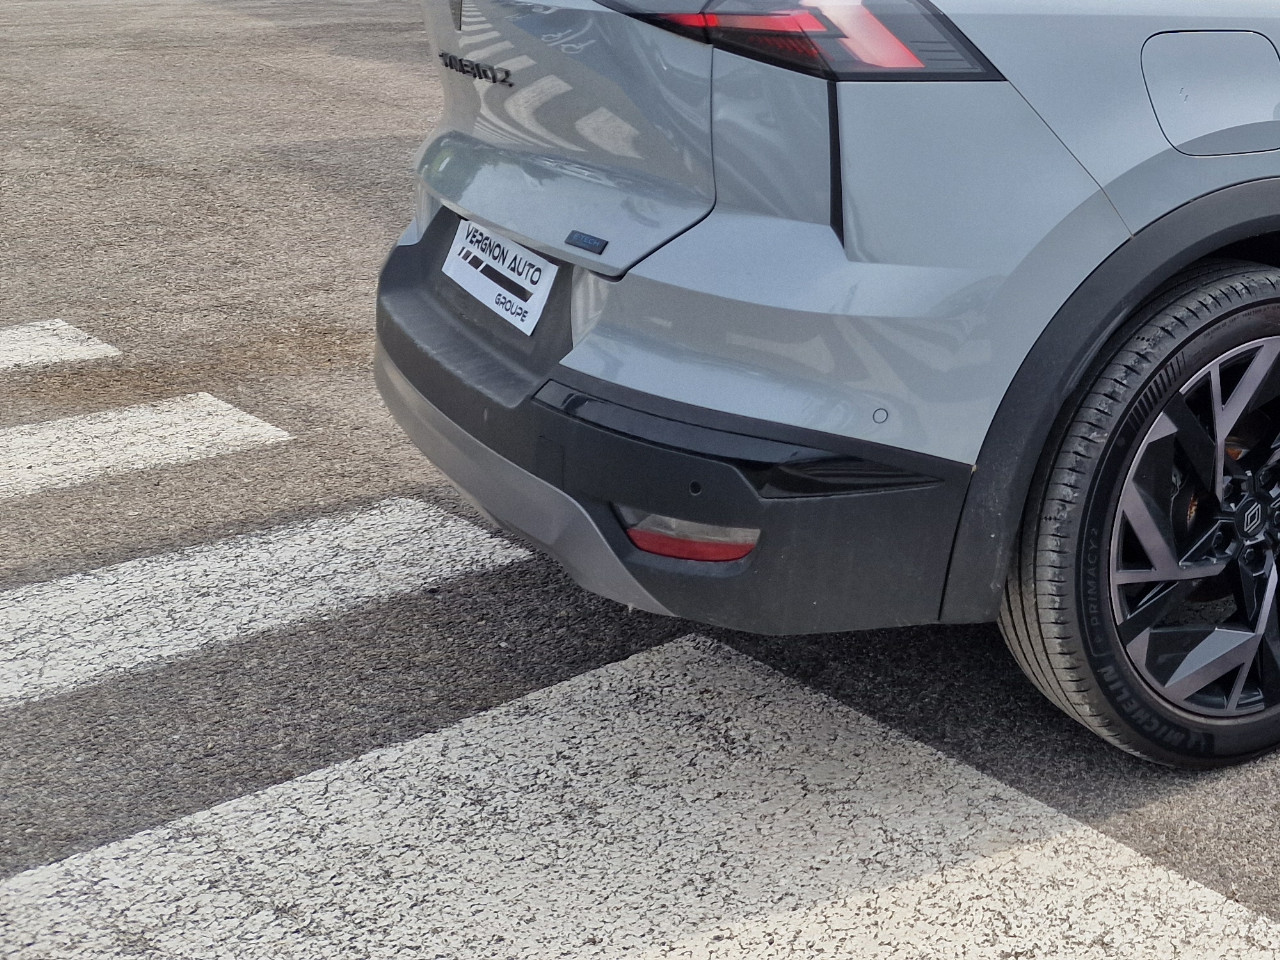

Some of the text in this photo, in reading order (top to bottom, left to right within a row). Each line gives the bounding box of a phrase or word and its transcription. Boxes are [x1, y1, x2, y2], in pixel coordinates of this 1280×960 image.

[465, 223, 542, 286] VERGNON AUTO
[494, 292, 529, 323] GROUPE
[1087, 539, 1101, 626] PRIMACY
[1097, 664, 1186, 747] MICHELIN
